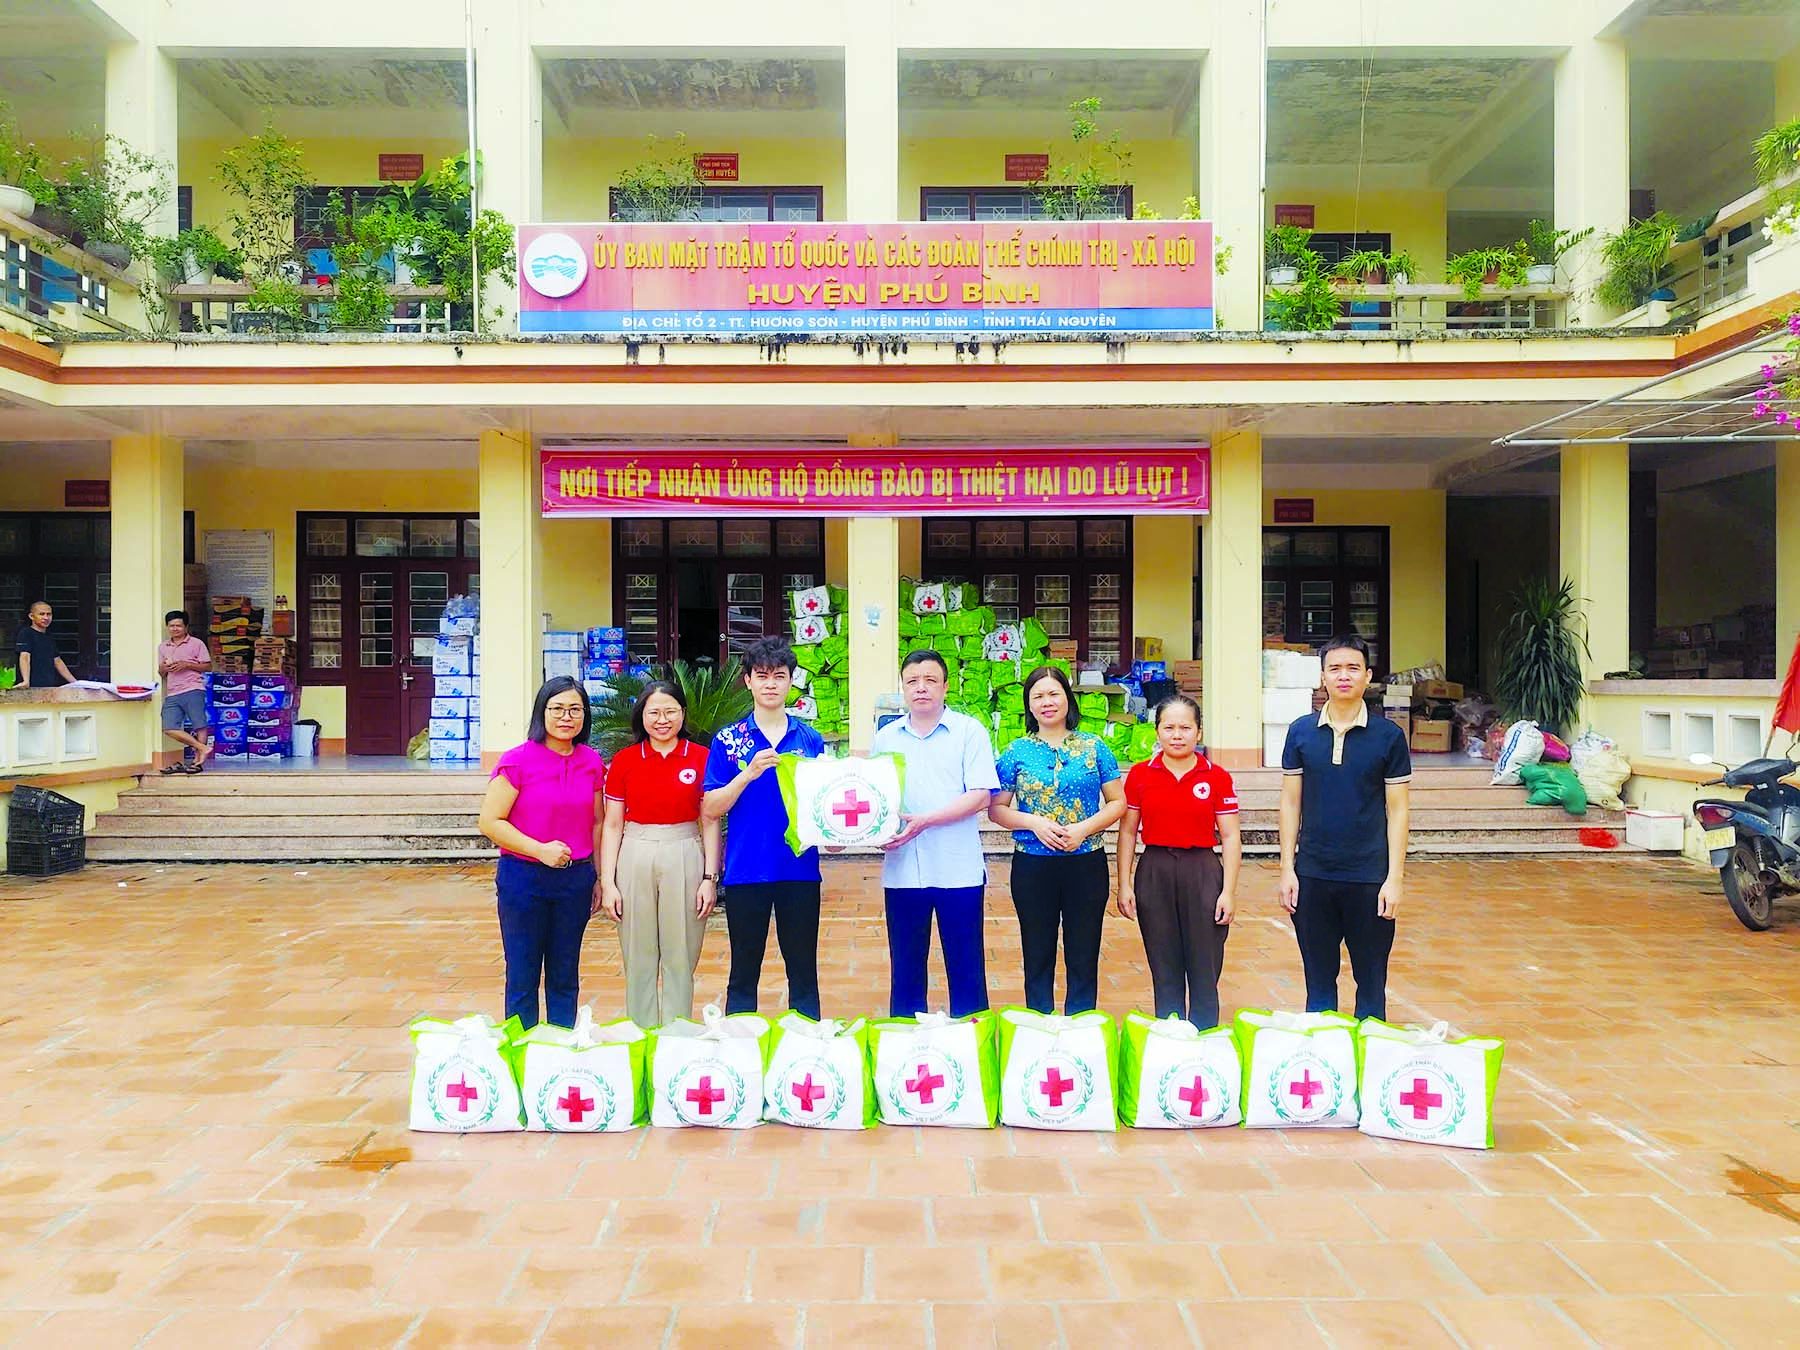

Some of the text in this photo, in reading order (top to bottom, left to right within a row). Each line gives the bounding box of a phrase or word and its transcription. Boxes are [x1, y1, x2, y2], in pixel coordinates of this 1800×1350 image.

[594, 231, 618, 269] ỦY
[624, 240, 664, 269] BAN
[668, 235, 708, 273] MẶT
[714, 235, 767, 273] TRẬN
[772, 228, 796, 268] TỔ
[801, 231, 849, 270] QUỐC
[854, 233, 879, 267] VÀ
[884, 233, 922, 267] CÁC
[927, 233, 981, 267] ĐOÀN
[985, 227, 1023, 267] THỂ
[1025, 233, 1083, 267] CHÍNH
[1088, 239, 1118, 271] TRỊ
[1131, 232, 1158, 267] XÃ
[1164, 233, 1195, 272] HỘI
[748, 273, 1040, 310] HUYỆN PHÚ BÌNH
[622, 316, 648, 330] ĐỊA
[685, 311, 703, 328] TỔ
[708, 317, 717, 328] 2
[729, 317, 745, 328] TT.
[808, 315, 838, 328] SƠN
[851, 313, 898, 329] HUYỆN
[902, 312, 930, 326] PHÚ
[935, 312, 968, 326] BÌNH
[983, 312, 1015, 327] TỈNH
[1020, 312, 1051, 326] THÁI
[1058, 313, 1116, 326] NGUYÊN
[560, 466, 598, 497] NƠI
[605, 459, 652, 497] TIẾP
[659, 462, 721, 504] NHẬN
[727, 458, 772, 497] ỦNG
[780, 462, 808, 503] HỘ
[815, 458, 875, 497] ĐỒNG
[881, 462, 925, 496] BÀO
[932, 467, 953, 503] BỊ
[960, 461, 1018, 502] THIỆT
[1024, 466, 1060, 502] HẠI
[1067, 466, 1097, 496] DO
[1103, 461, 1129, 495] LŨ
[1136, 466, 1174, 501] LỤT
